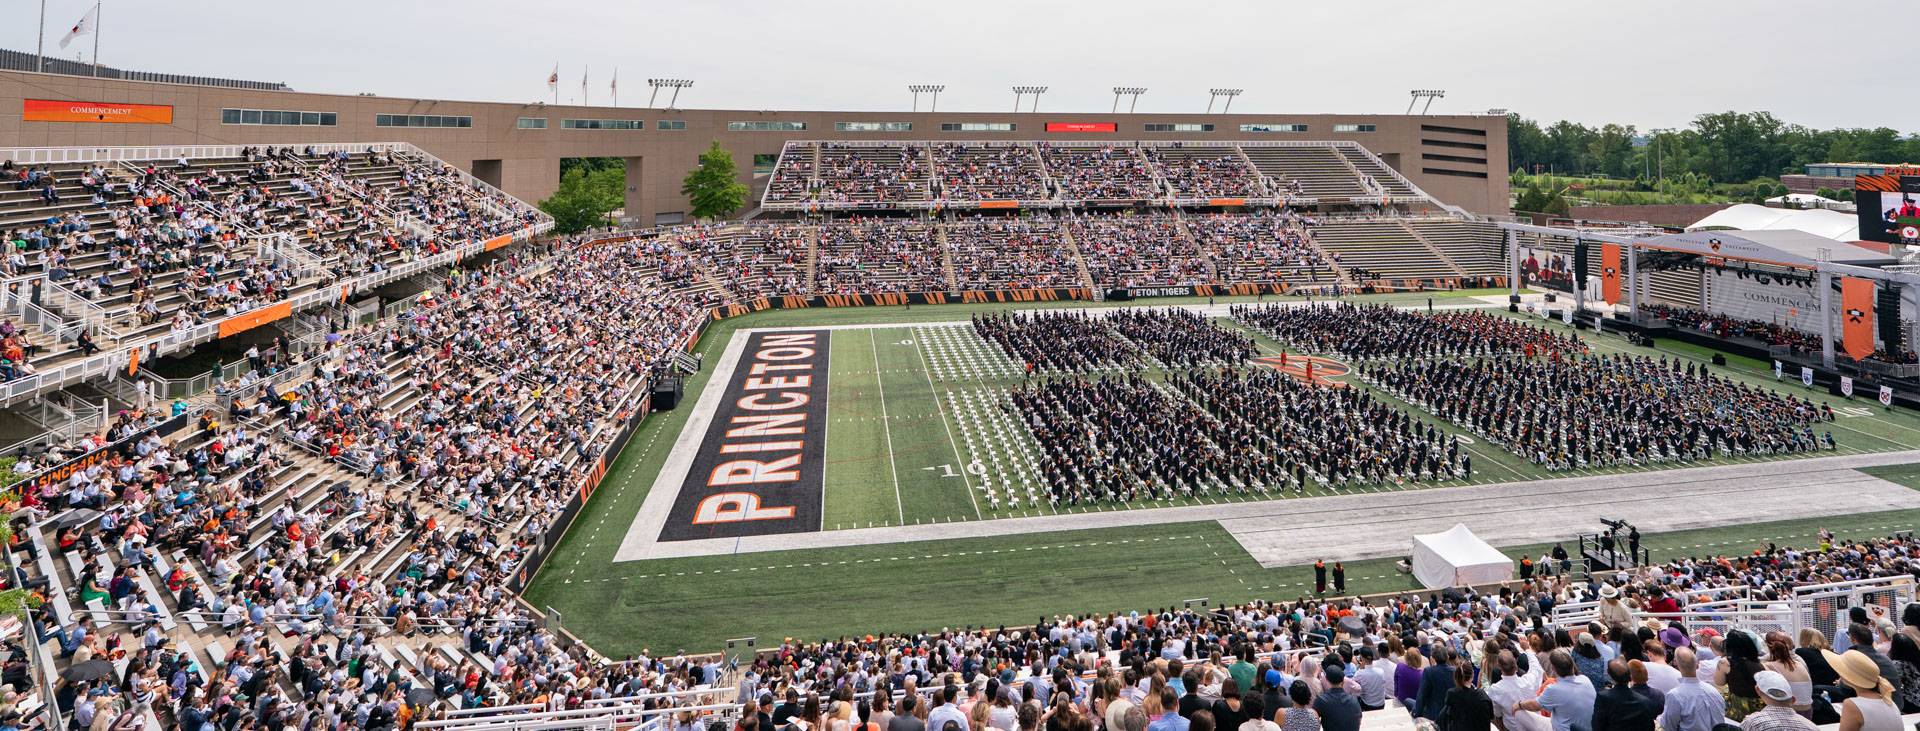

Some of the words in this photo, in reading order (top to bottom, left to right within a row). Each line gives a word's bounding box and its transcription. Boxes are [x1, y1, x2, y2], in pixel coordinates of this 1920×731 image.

[70, 106, 131, 115] COMMENCEMENT
[1160, 287, 1190, 296] TIGERS
[692, 333, 817, 525] PRINCETON
[39, 463, 77, 486] SINCE
[1838, 597, 1847, 606] 10
